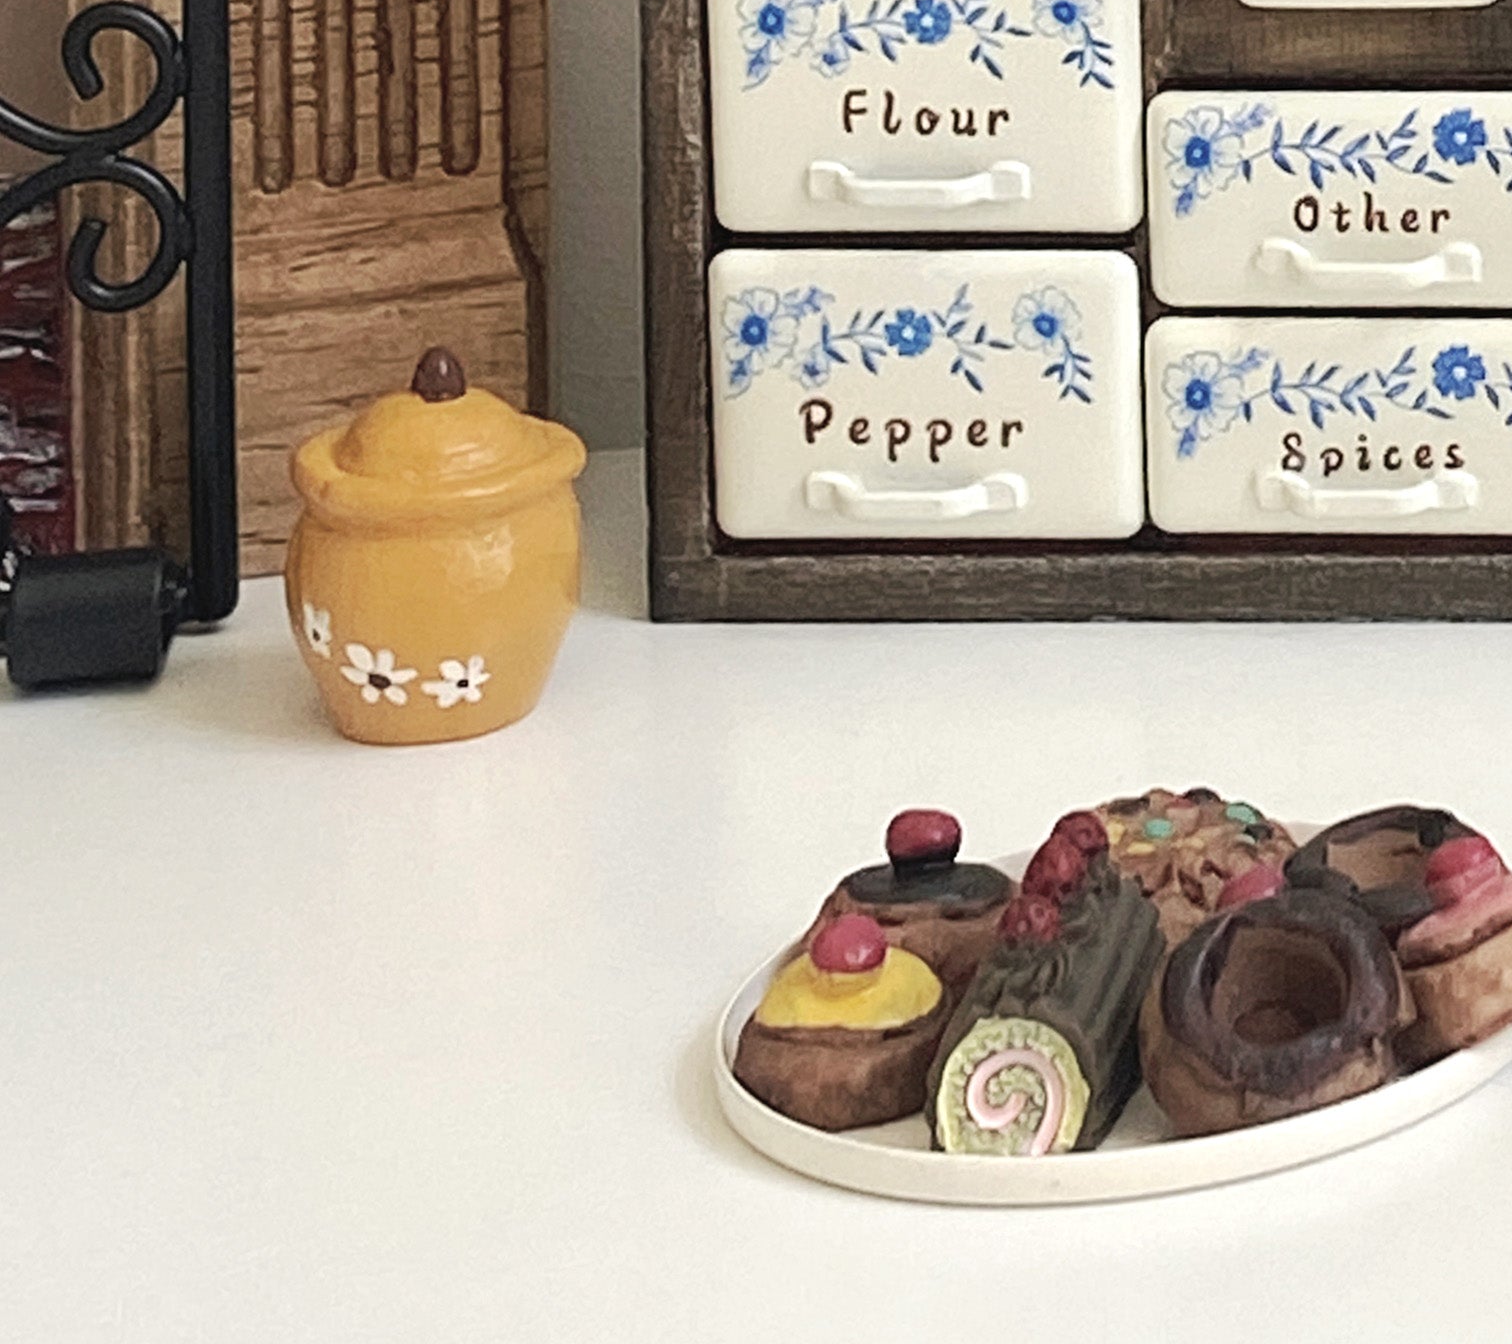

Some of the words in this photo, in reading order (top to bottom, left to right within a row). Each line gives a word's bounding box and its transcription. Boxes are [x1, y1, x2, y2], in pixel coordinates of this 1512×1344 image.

[841, 87, 1011, 139] Flour
[1292, 190, 1452, 236] Other
[798, 397, 1025, 462] Pepper
[1280, 431, 1466, 478] Spices
